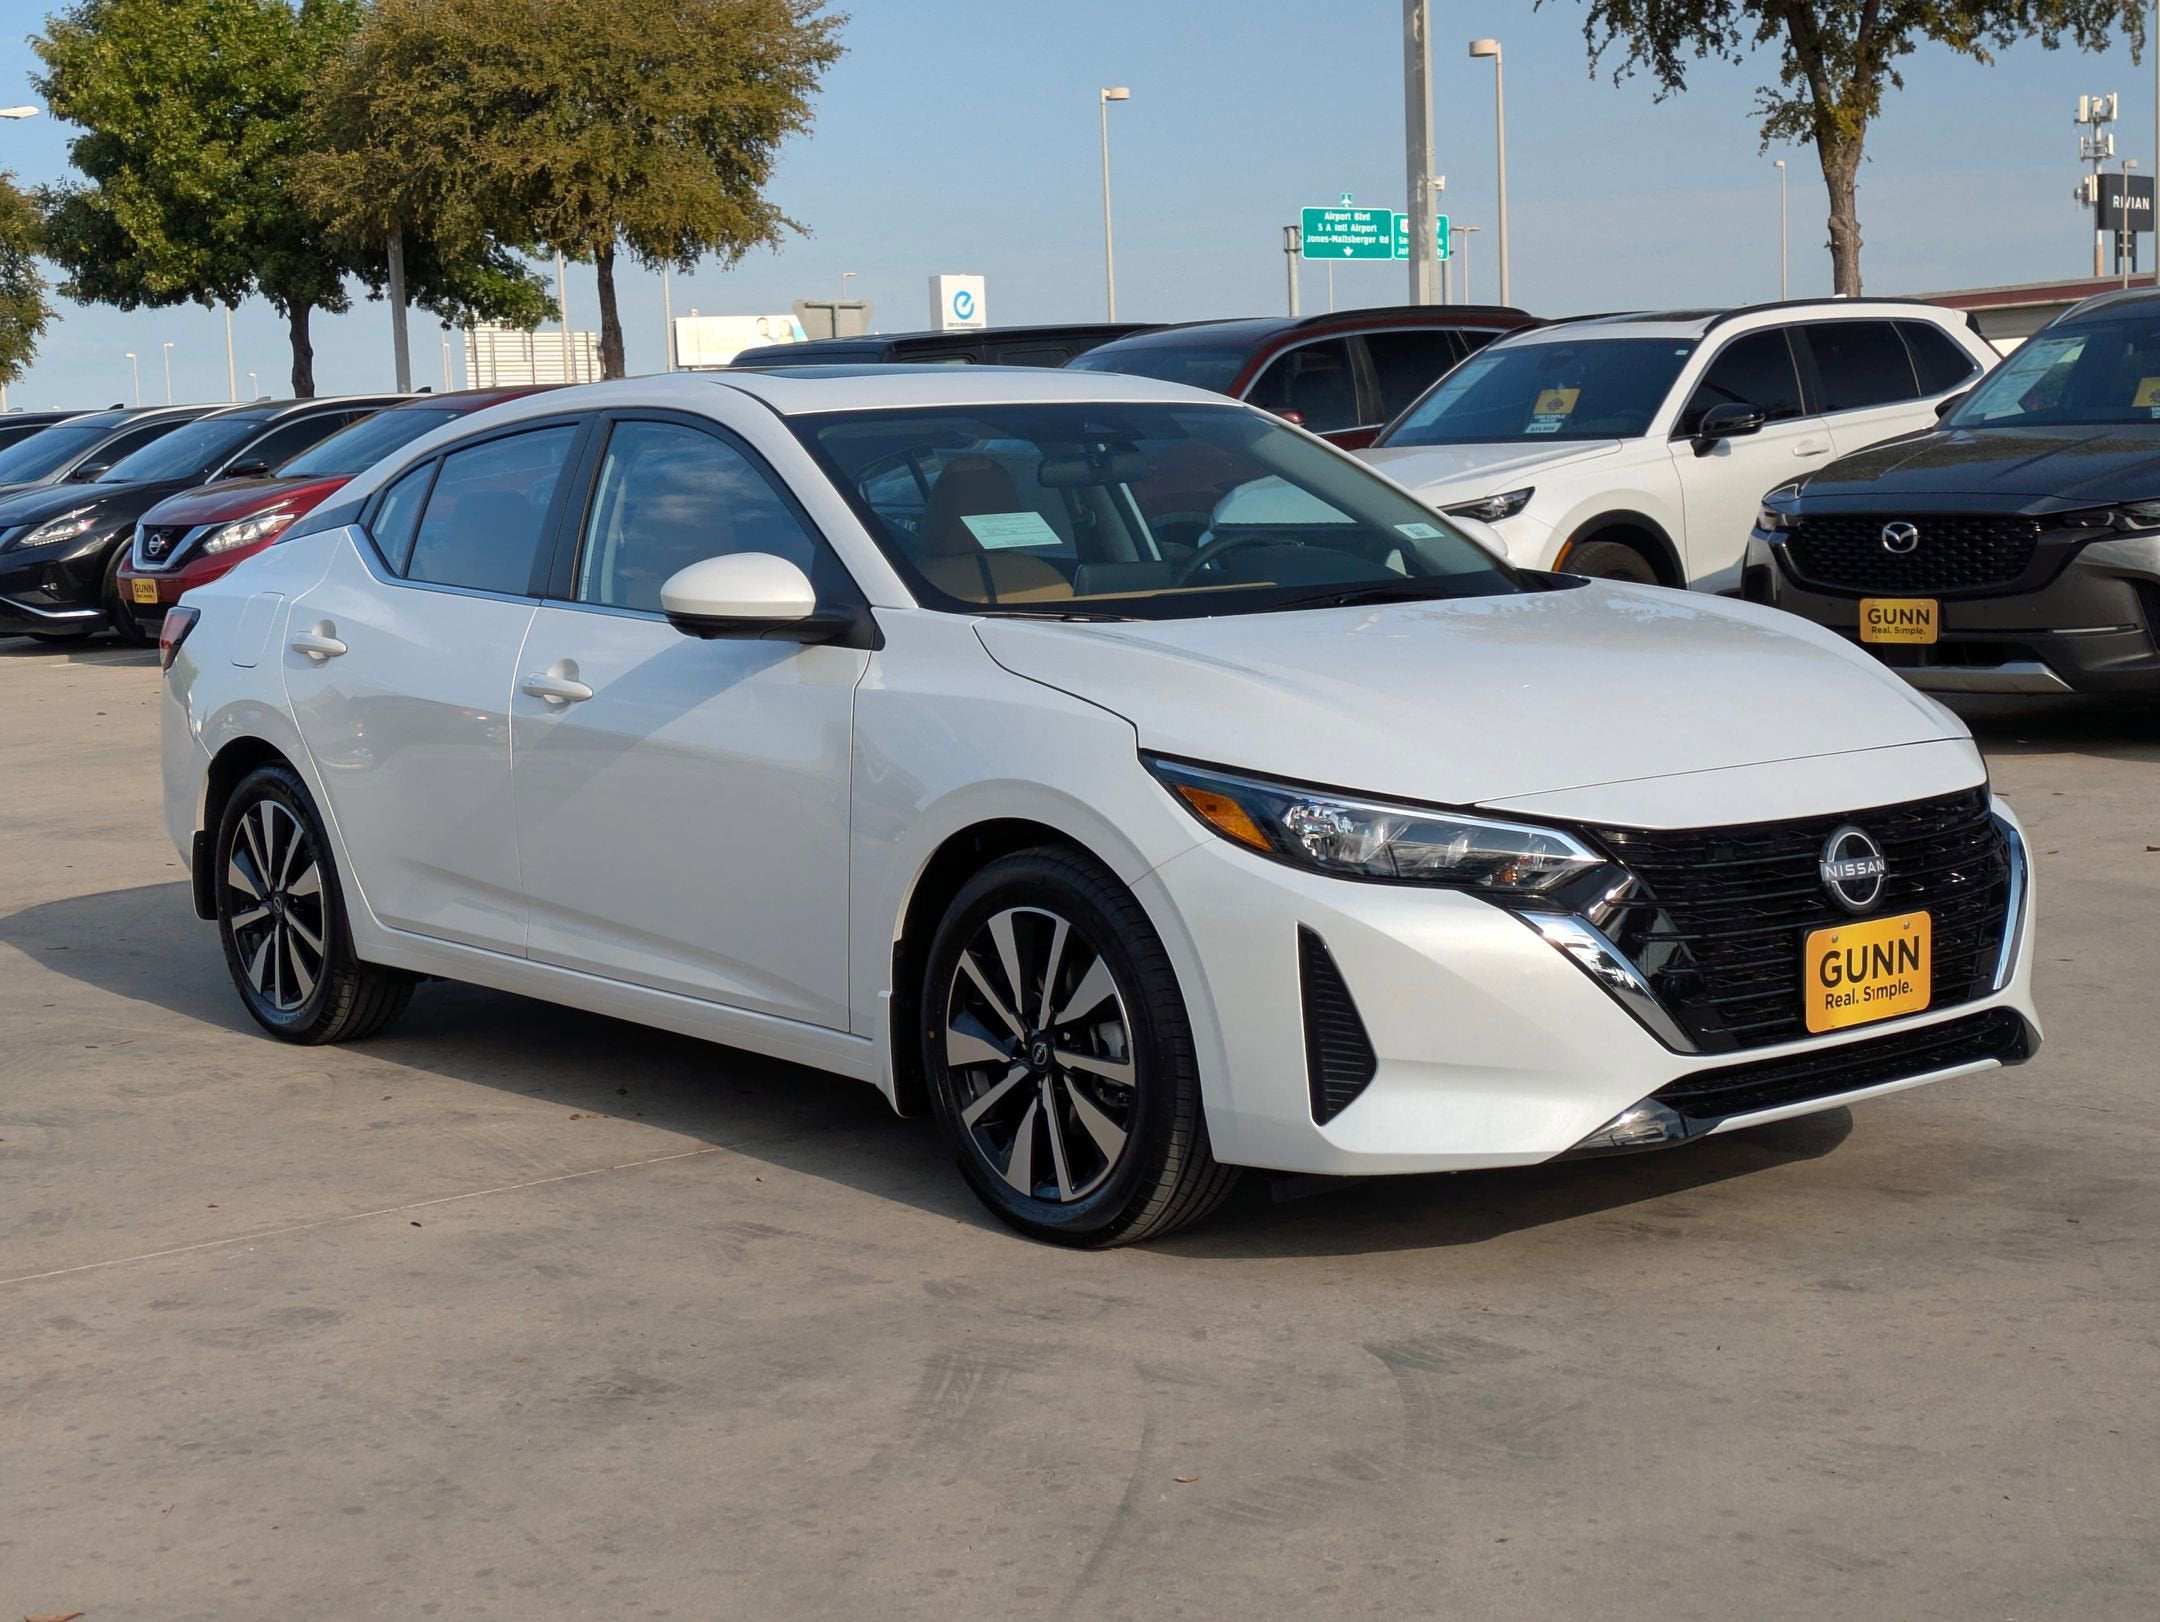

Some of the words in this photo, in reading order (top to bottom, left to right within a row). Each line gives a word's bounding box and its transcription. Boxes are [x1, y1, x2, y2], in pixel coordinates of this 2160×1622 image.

[2113, 195, 2150, 210] RIVIAN
[1324, 211, 1351, 222] Airport
[1354, 212, 1371, 221] Blvd
[1318, 223, 1323, 231] S
[1326, 223, 1331, 231] A
[1335, 223, 1348, 232] Intl
[1351, 223, 1377, 234] Airport
[1379, 235, 1389, 244] Rd
[135, 584, 154, 593] GUNN
[1867, 607, 1930, 625] GUNN
[1826, 859, 1885, 878] NISSAN
[1819, 935, 1920, 989] GUNN
[1825, 988, 1859, 1010] Real.
